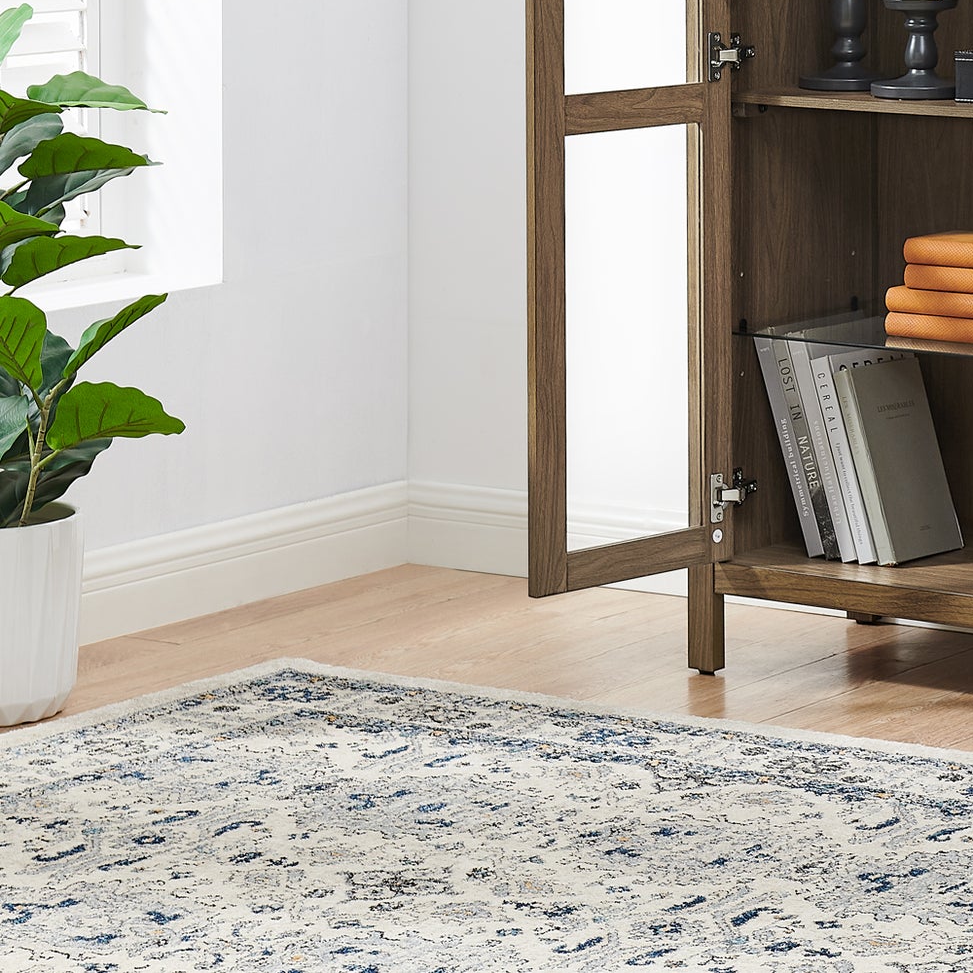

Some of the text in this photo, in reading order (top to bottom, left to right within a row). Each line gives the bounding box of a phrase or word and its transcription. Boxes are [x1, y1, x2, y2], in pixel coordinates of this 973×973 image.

[777, 357, 820, 489] LOST IN NATURE
[817, 372, 838, 433] CEREAL
[780, 418, 810, 517] Symmetrical building
